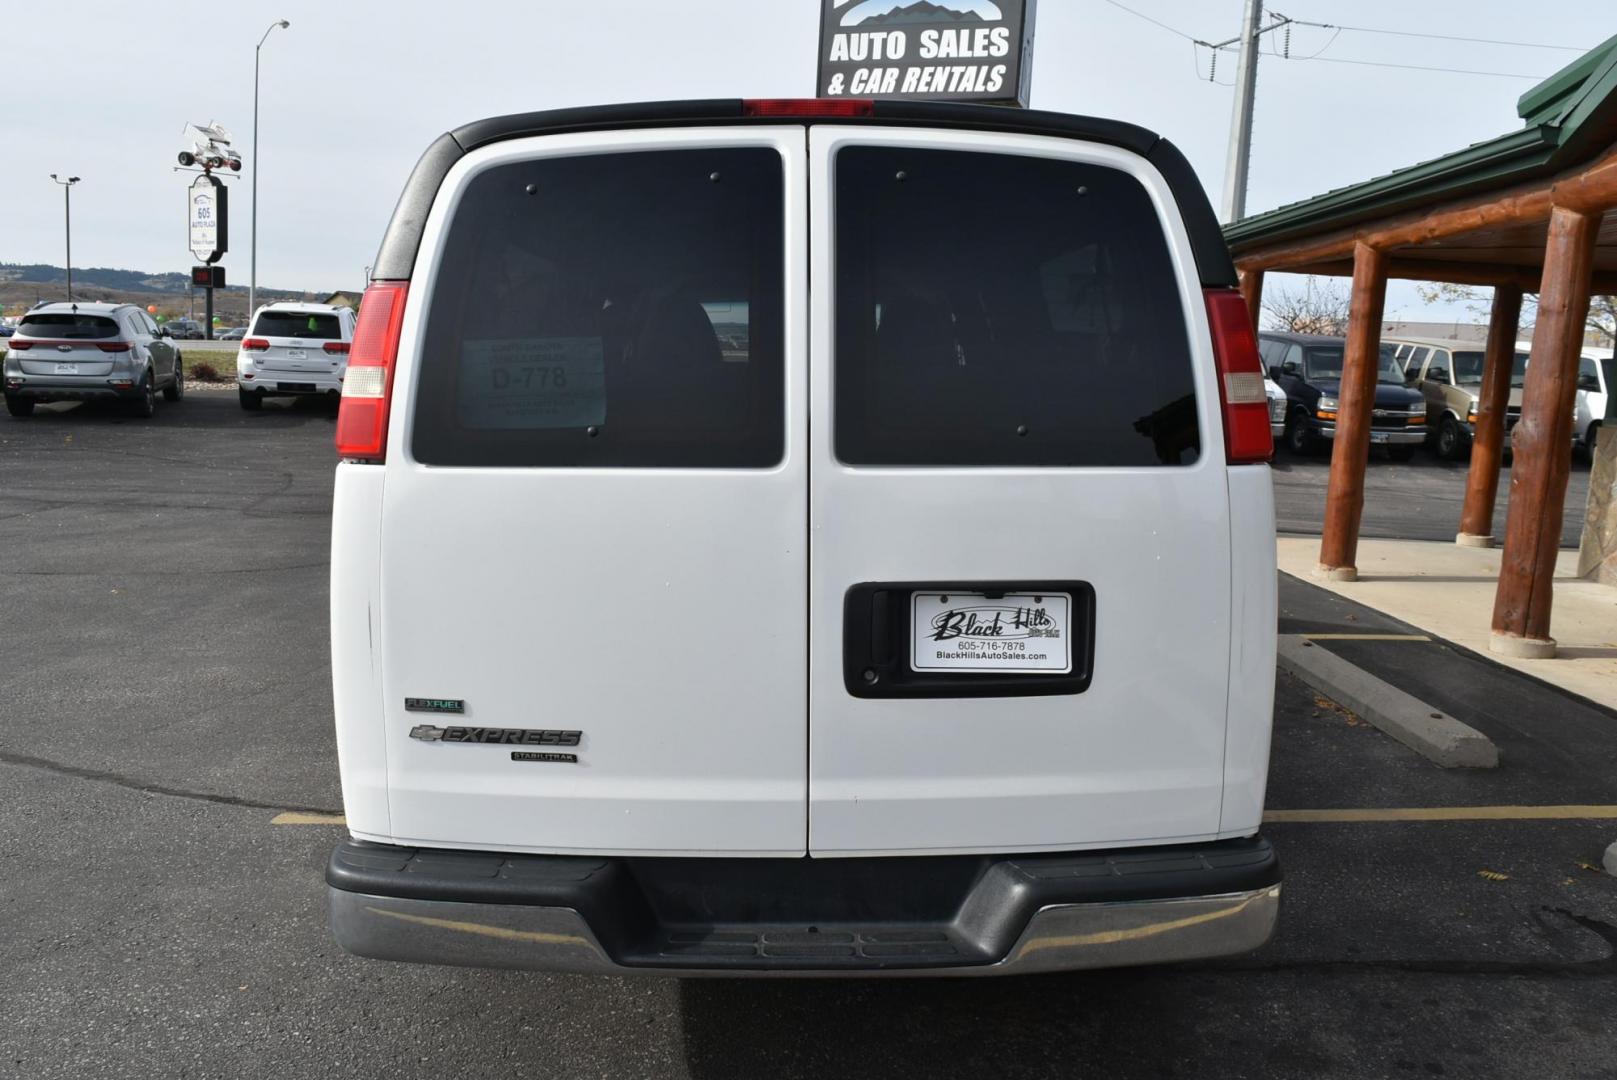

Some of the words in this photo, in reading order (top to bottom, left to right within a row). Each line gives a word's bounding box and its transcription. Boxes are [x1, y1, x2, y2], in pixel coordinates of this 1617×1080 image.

[829, 31, 906, 62] AUTO
[919, 27, 1010, 59] SALES
[827, 72, 845, 95] &
[850, 67, 900, 94] CAR
[901, 64, 1007, 93] RENTALS
[198, 208, 210, 218] 605
[493, 367, 567, 389] D-778
[928, 609, 1003, 642] Black
[1010, 606, 1051, 629] Hills
[958, 641, 1026, 651] 605-716-7878
[936, 651, 1047, 661] BlackHillsAutoSales.com
[406, 699, 461, 710] FLEXFUEL
[442, 726, 583, 746] EXPRESS
[513, 751, 573, 761] STABILITRAK
